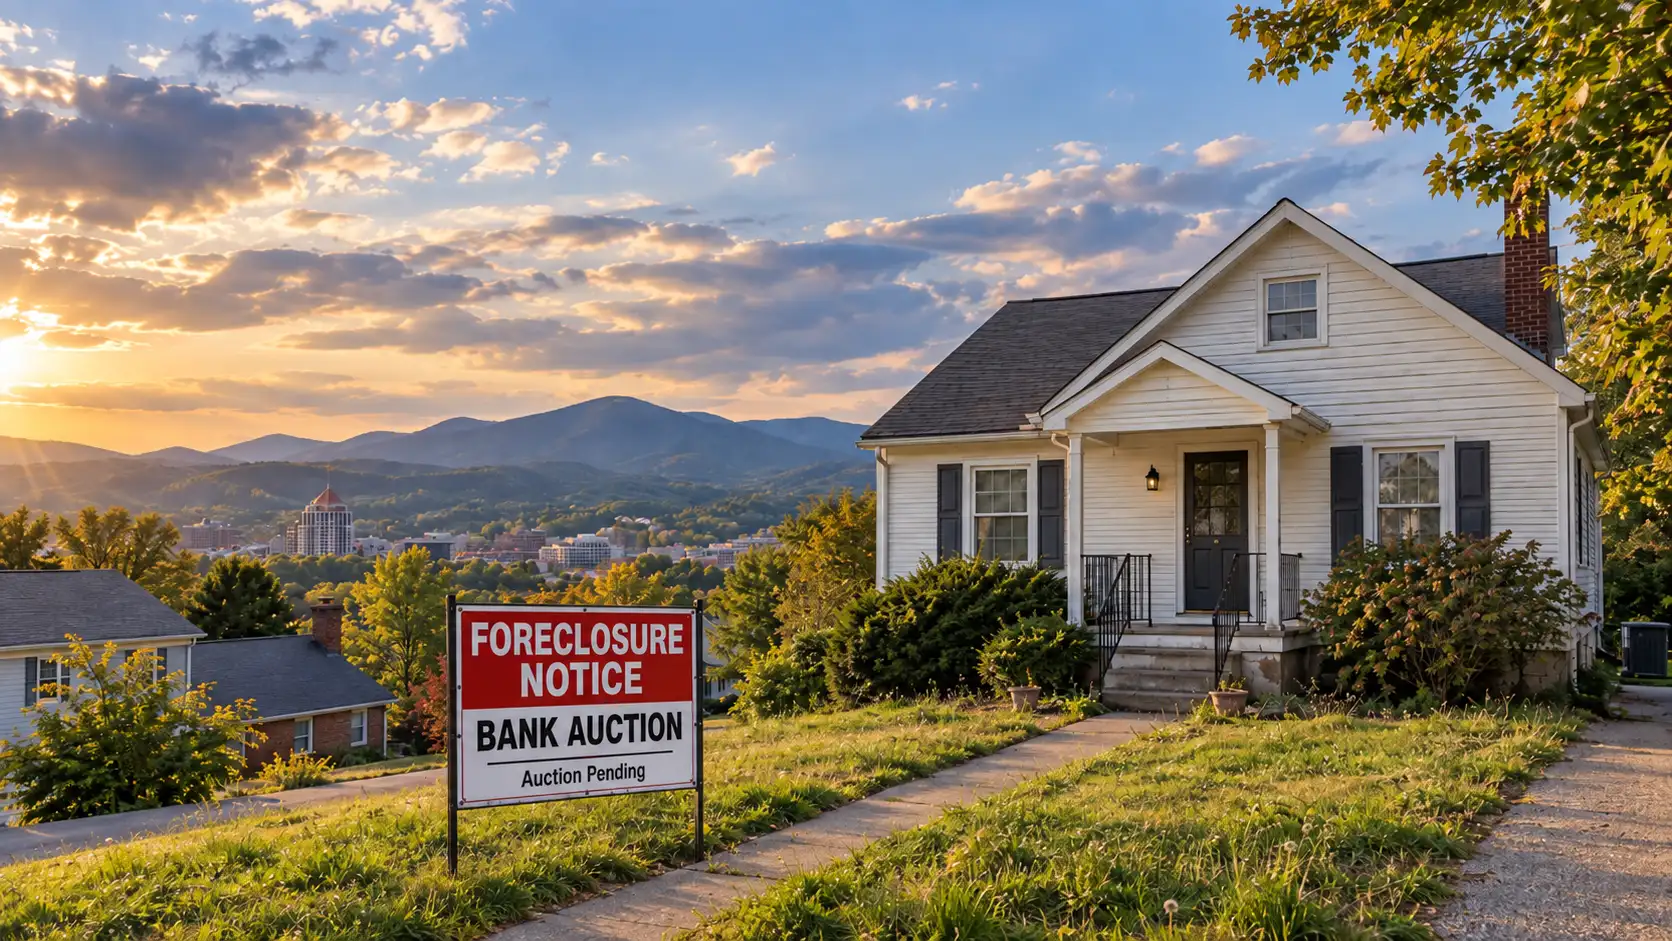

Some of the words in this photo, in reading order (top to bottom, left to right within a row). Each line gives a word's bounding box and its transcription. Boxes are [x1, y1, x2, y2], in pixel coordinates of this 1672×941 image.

[471, 622, 684, 656] FORECLOSURE
[520, 661, 643, 698] NOTICE
[476, 716, 559, 752] BANK
[567, 711, 683, 746] AUCTION
[521, 767, 582, 788] Auction
[587, 763, 646, 782] Pending
